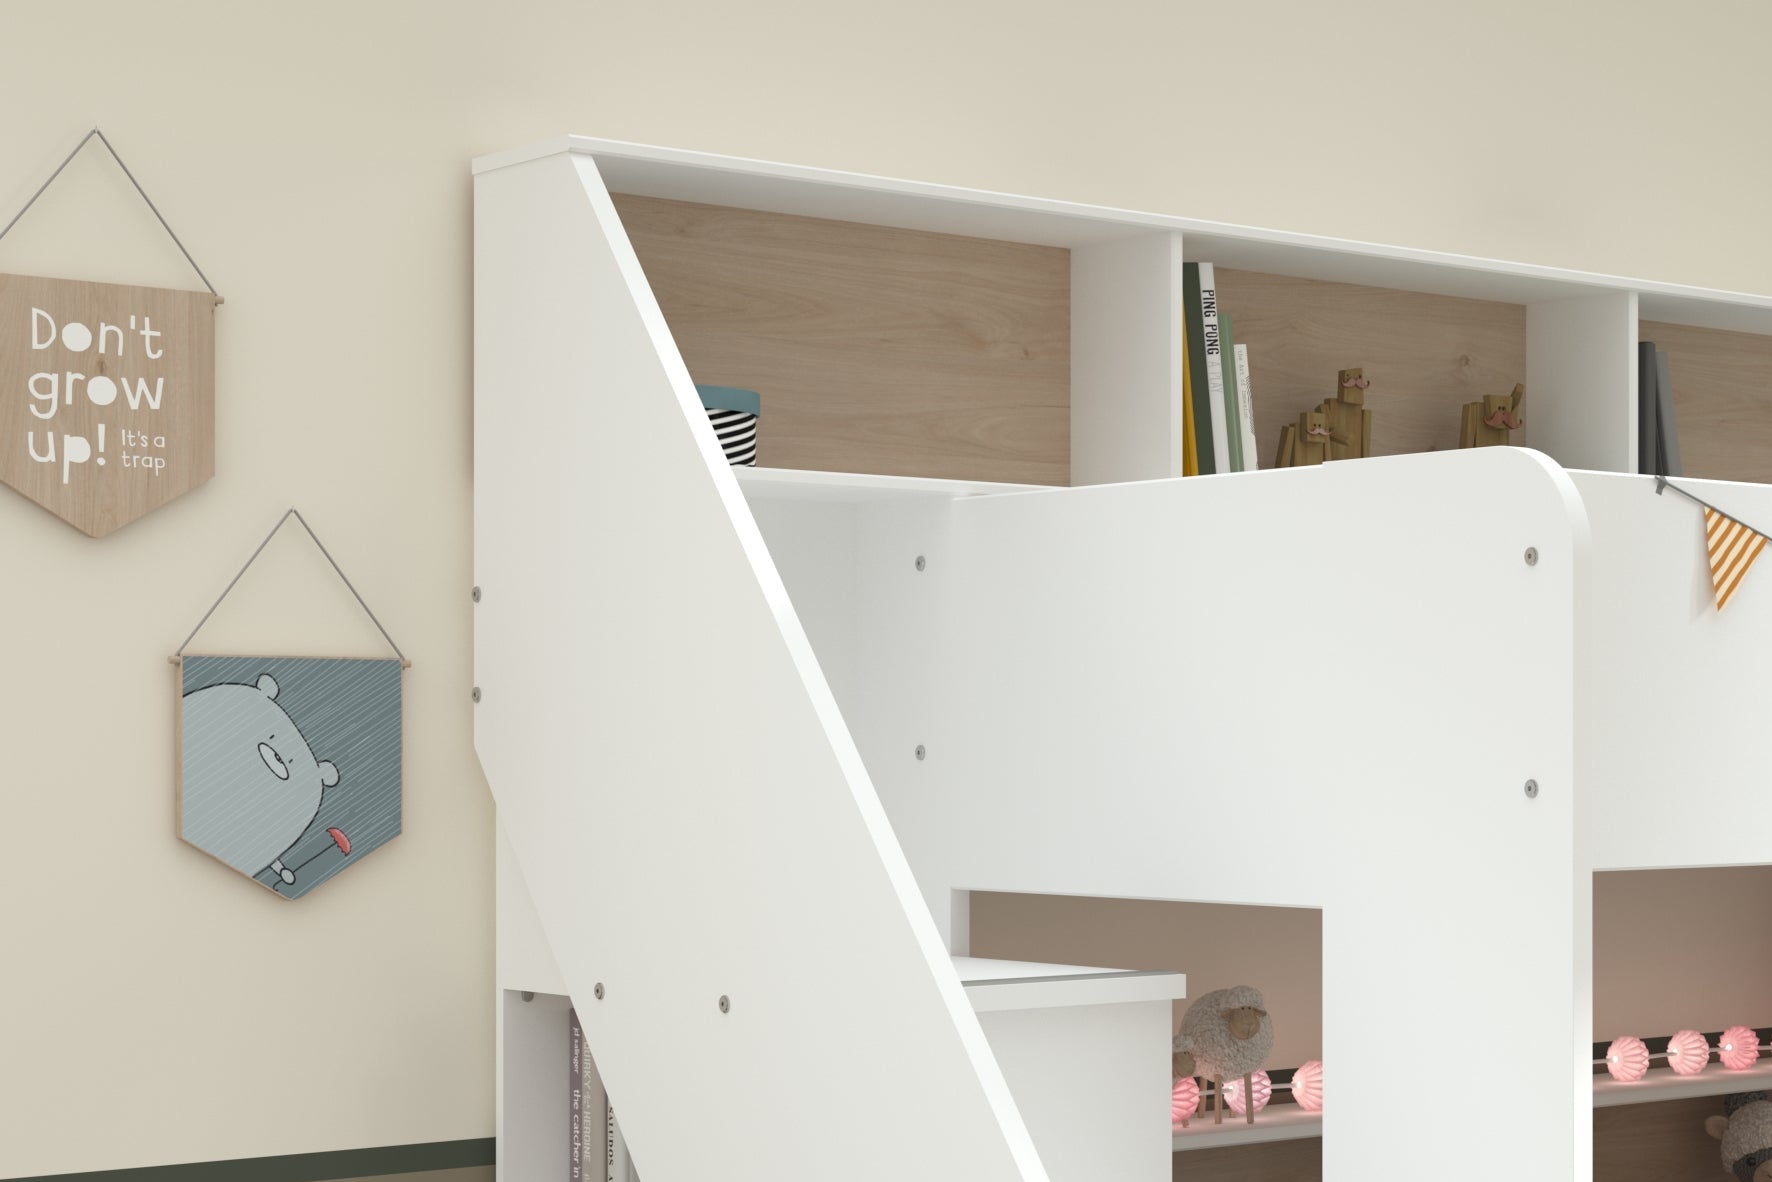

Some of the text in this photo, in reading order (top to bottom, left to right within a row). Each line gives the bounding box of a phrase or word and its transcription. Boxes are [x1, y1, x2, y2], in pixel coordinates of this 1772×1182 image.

[1202, 290, 1216, 317] PING
[31, 306, 164, 360] Don't
[1205, 324, 1219, 355] PONG
[28, 371, 164, 420] grow
[28, 423, 106, 485] up!
[121, 428, 165, 448] It's a
[121, 450, 166, 477] trap
[572, 1038, 581, 1074] salinger
[573, 1089, 582, 1110] the
[573, 1113, 582, 1163] catcher
[583, 1111, 591, 1162] HEROINE
[573, 1165, 582, 1179] in
